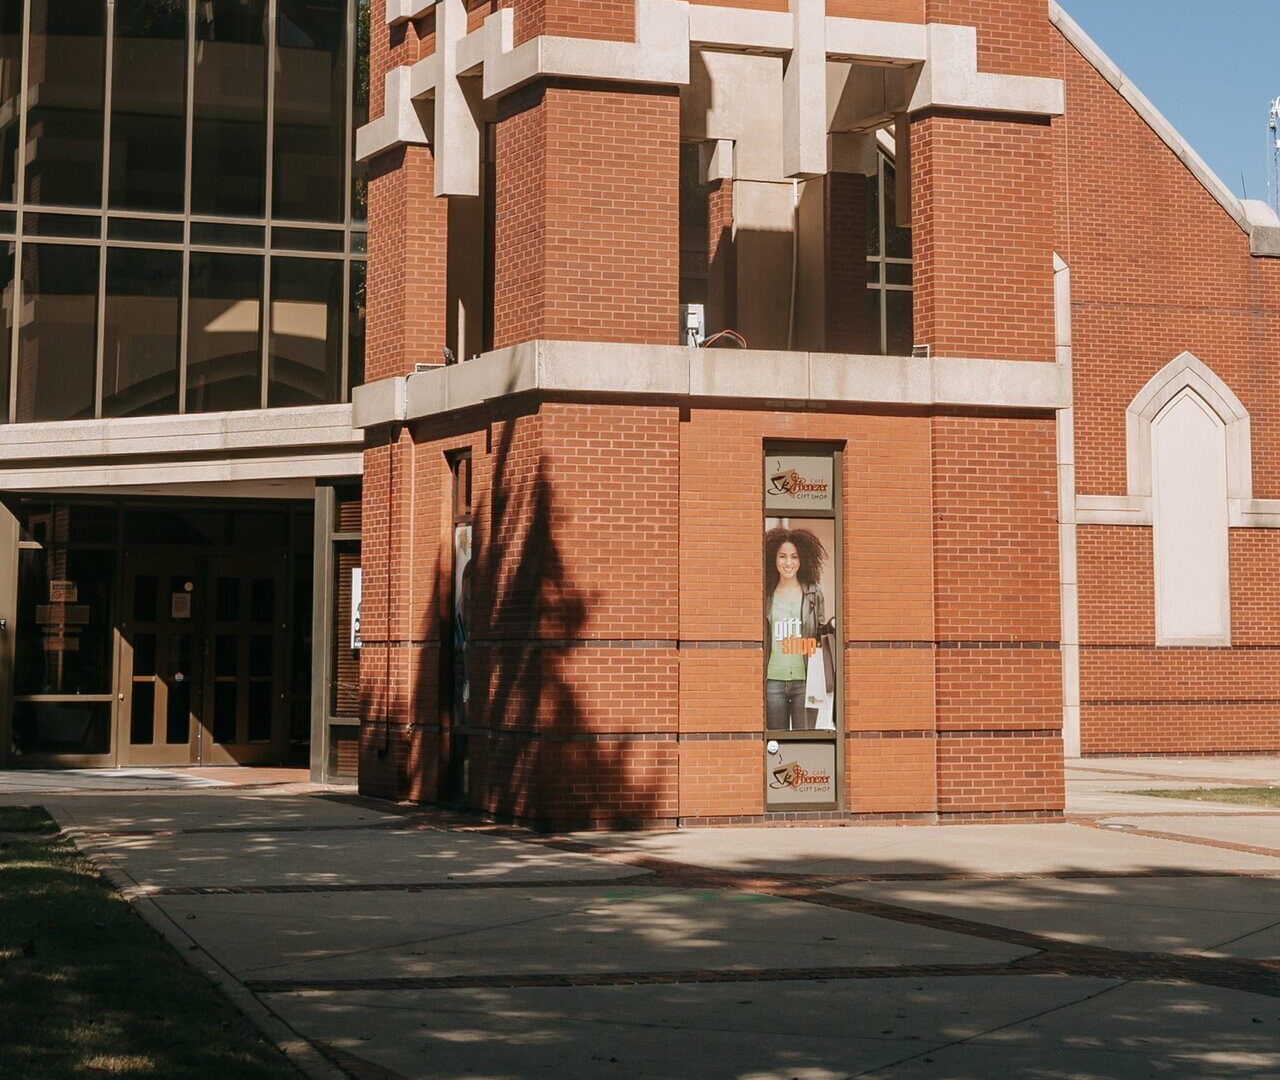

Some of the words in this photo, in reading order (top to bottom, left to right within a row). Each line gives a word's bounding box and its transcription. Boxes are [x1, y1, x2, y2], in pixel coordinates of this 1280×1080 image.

[790, 472, 828, 494] Ebenezer
[775, 617, 802, 641] gift
[781, 634, 817, 656] shop
[792, 764, 830, 788] Ebenezer
